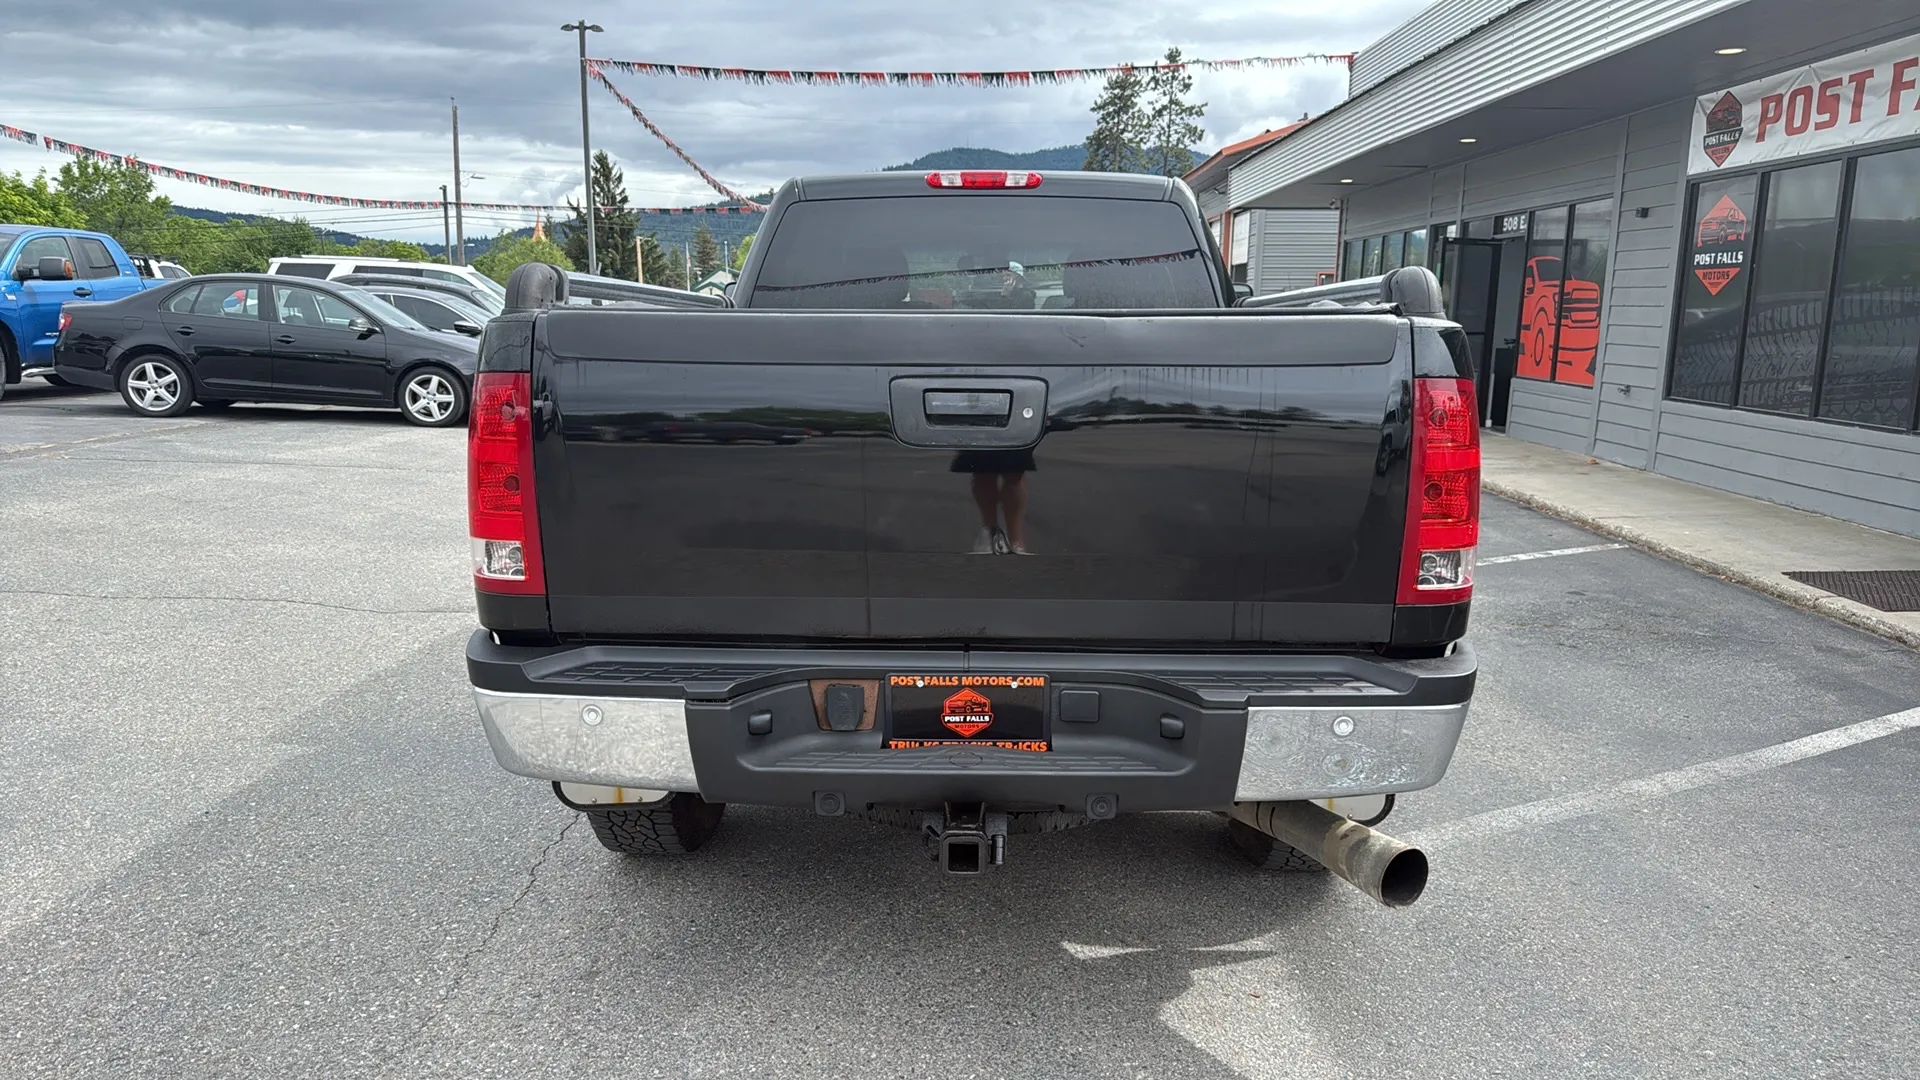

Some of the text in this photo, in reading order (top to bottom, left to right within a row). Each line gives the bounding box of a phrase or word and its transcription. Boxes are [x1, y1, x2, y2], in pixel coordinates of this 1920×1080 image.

[1755, 56, 1920, 143] POST F
[1704, 130, 1741, 146] POST FALLS
[1502, 216, 1518, 231] 508
[1694, 251, 1743, 265] POST FALLS
[1702, 271, 1730, 280] MOTORS
[890, 676, 1045, 686] POST FALLS MOTORSCOM
